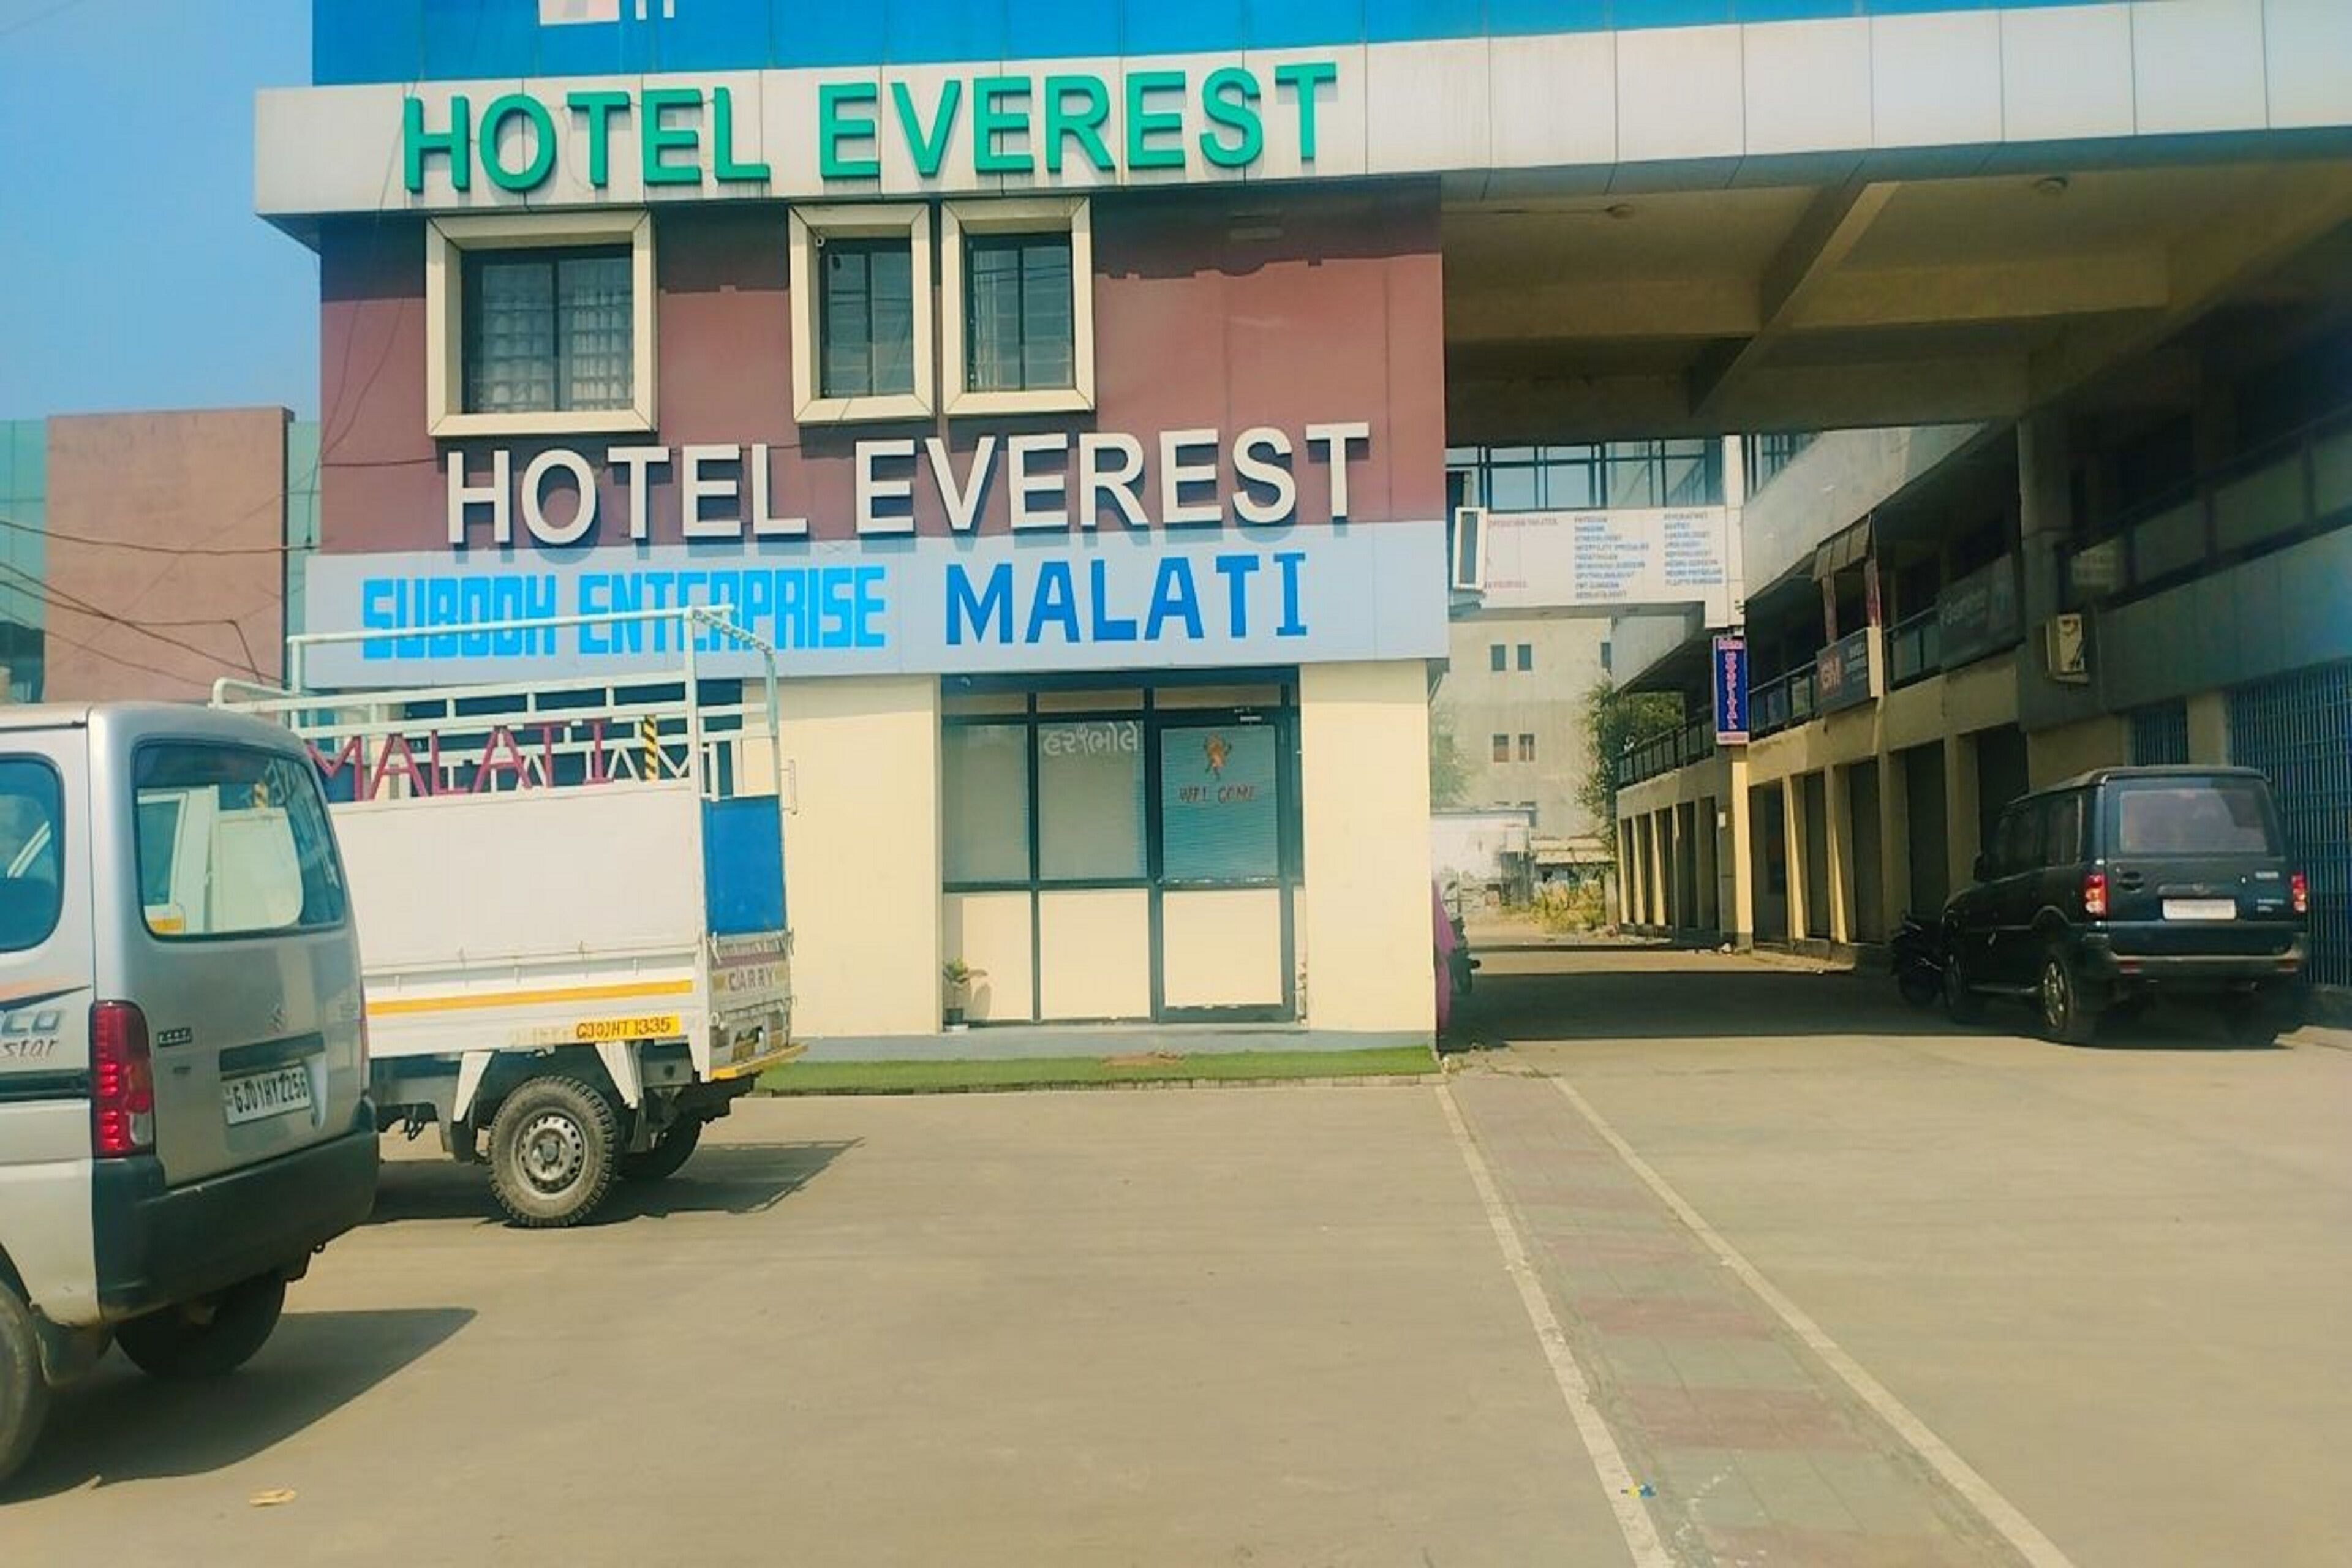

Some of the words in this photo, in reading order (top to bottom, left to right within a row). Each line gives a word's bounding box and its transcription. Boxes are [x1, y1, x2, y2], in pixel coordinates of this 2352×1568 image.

[404, 87, 771, 193] HOTEL
[819, 62, 1336, 179] EVEREST
[447, 443, 808, 545] HOTEL
[855, 422, 1370, 534] EVEREST
[363, 574, 556, 660] SUBODH
[578, 566, 885, 655] ENTERPRISE
[946, 552, 1308, 646] MALATI
[306, 718, 613, 801] MALATI
